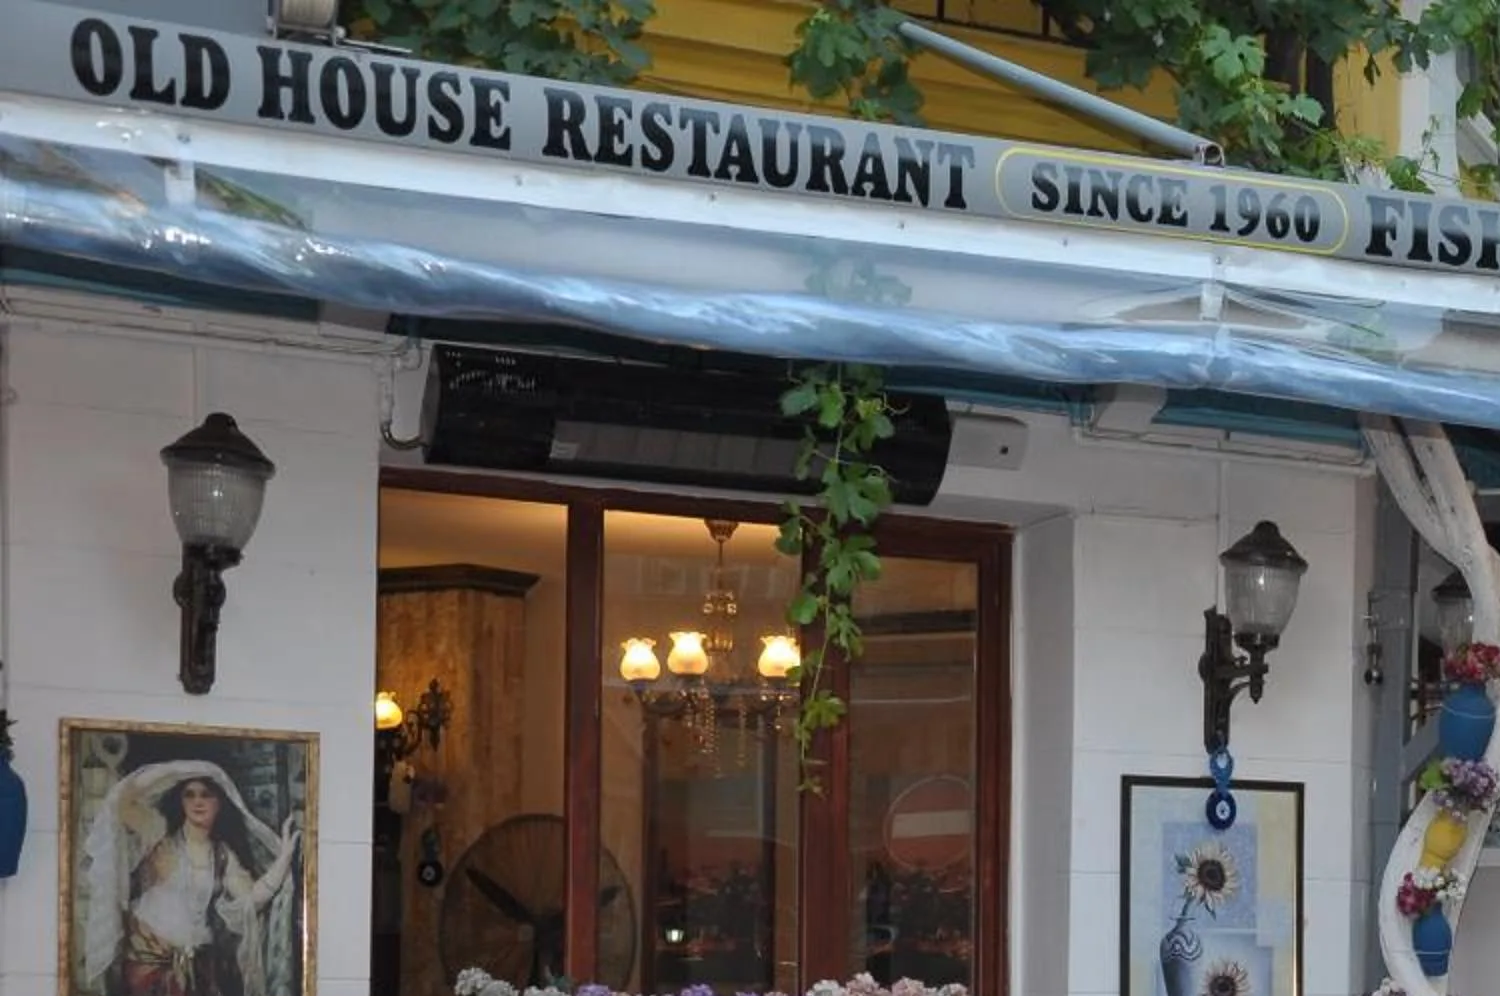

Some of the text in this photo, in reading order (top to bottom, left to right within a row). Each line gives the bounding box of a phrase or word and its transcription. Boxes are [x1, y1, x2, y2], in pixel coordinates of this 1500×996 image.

[70, 18, 976, 209] OLD HOUSE RESTAURANT
[1031, 161, 1321, 243] SINCE 1960
